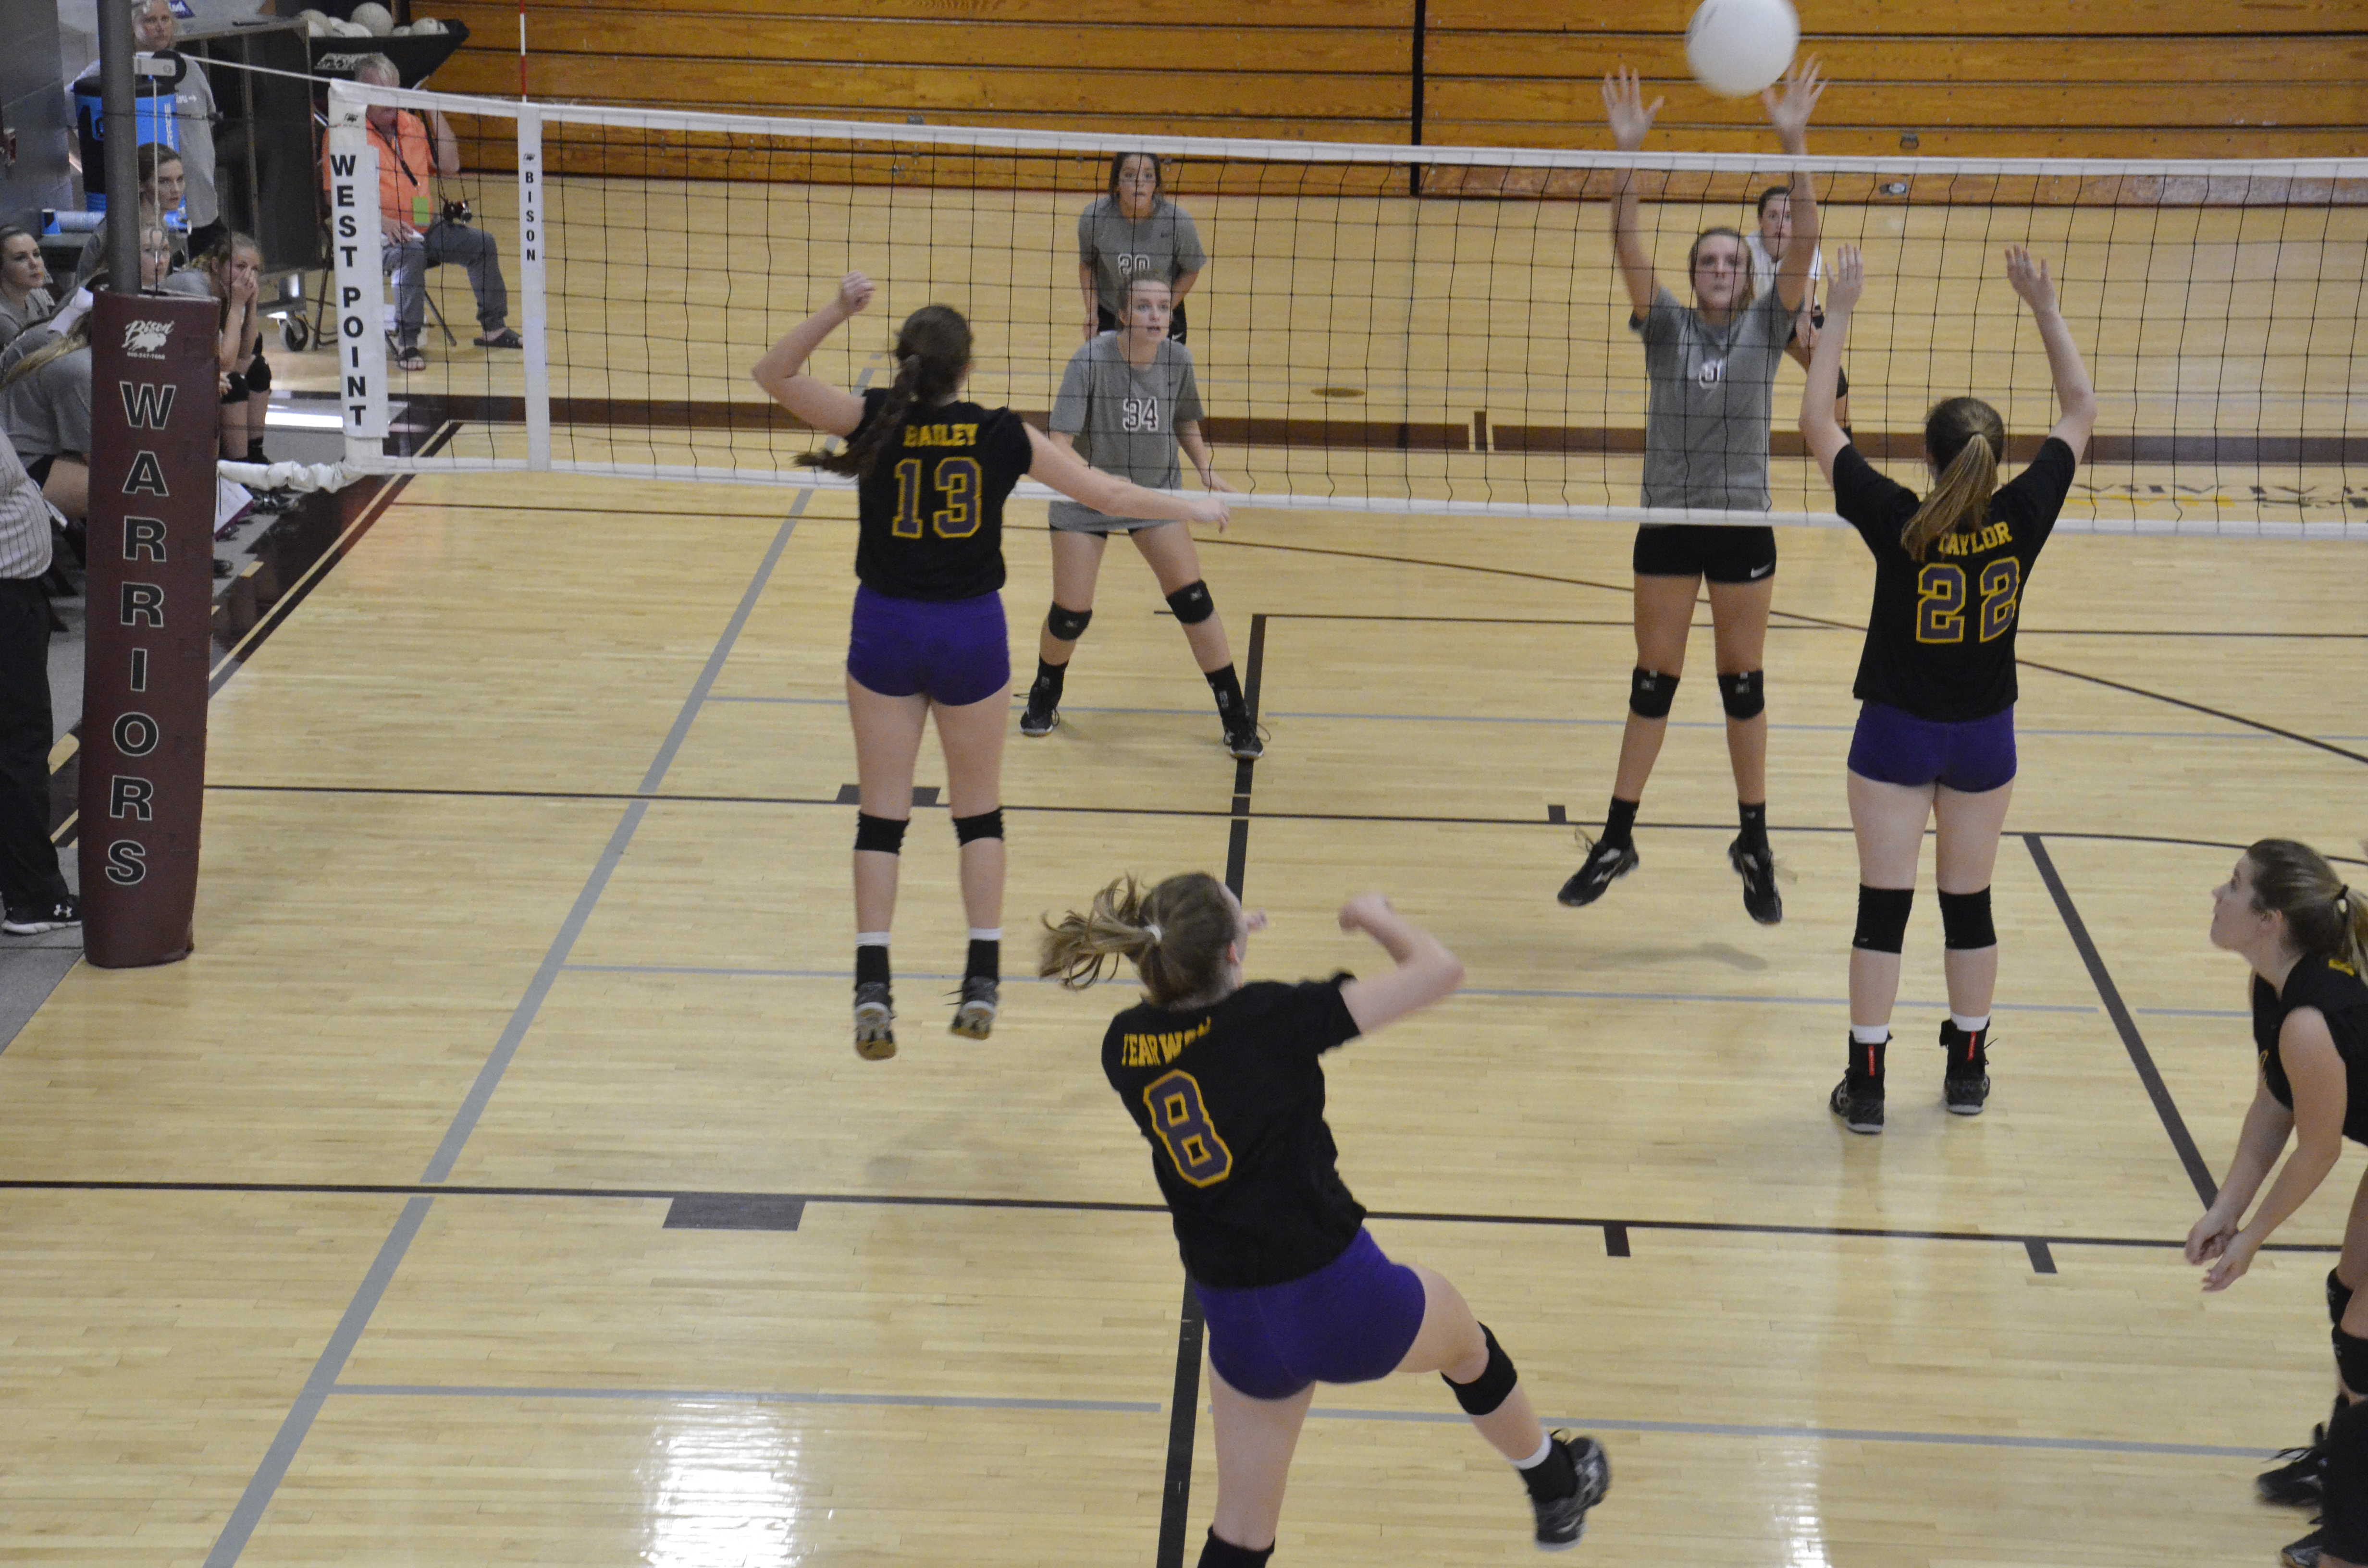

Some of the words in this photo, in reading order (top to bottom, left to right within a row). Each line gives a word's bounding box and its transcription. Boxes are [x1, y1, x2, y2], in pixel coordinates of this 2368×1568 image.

[330, 154, 358, 268] WEST
[525, 171, 536, 261] BISON
[343, 286, 367, 426] POINT
[902, 423, 979, 447] BAILEY
[1122, 396, 1159, 431] 34
[892, 457, 982, 539] 13
[105, 381, 176, 885] WARRIORS
[1916, 556, 2020, 643] 22
[1143, 1068, 1233, 1188] 8
